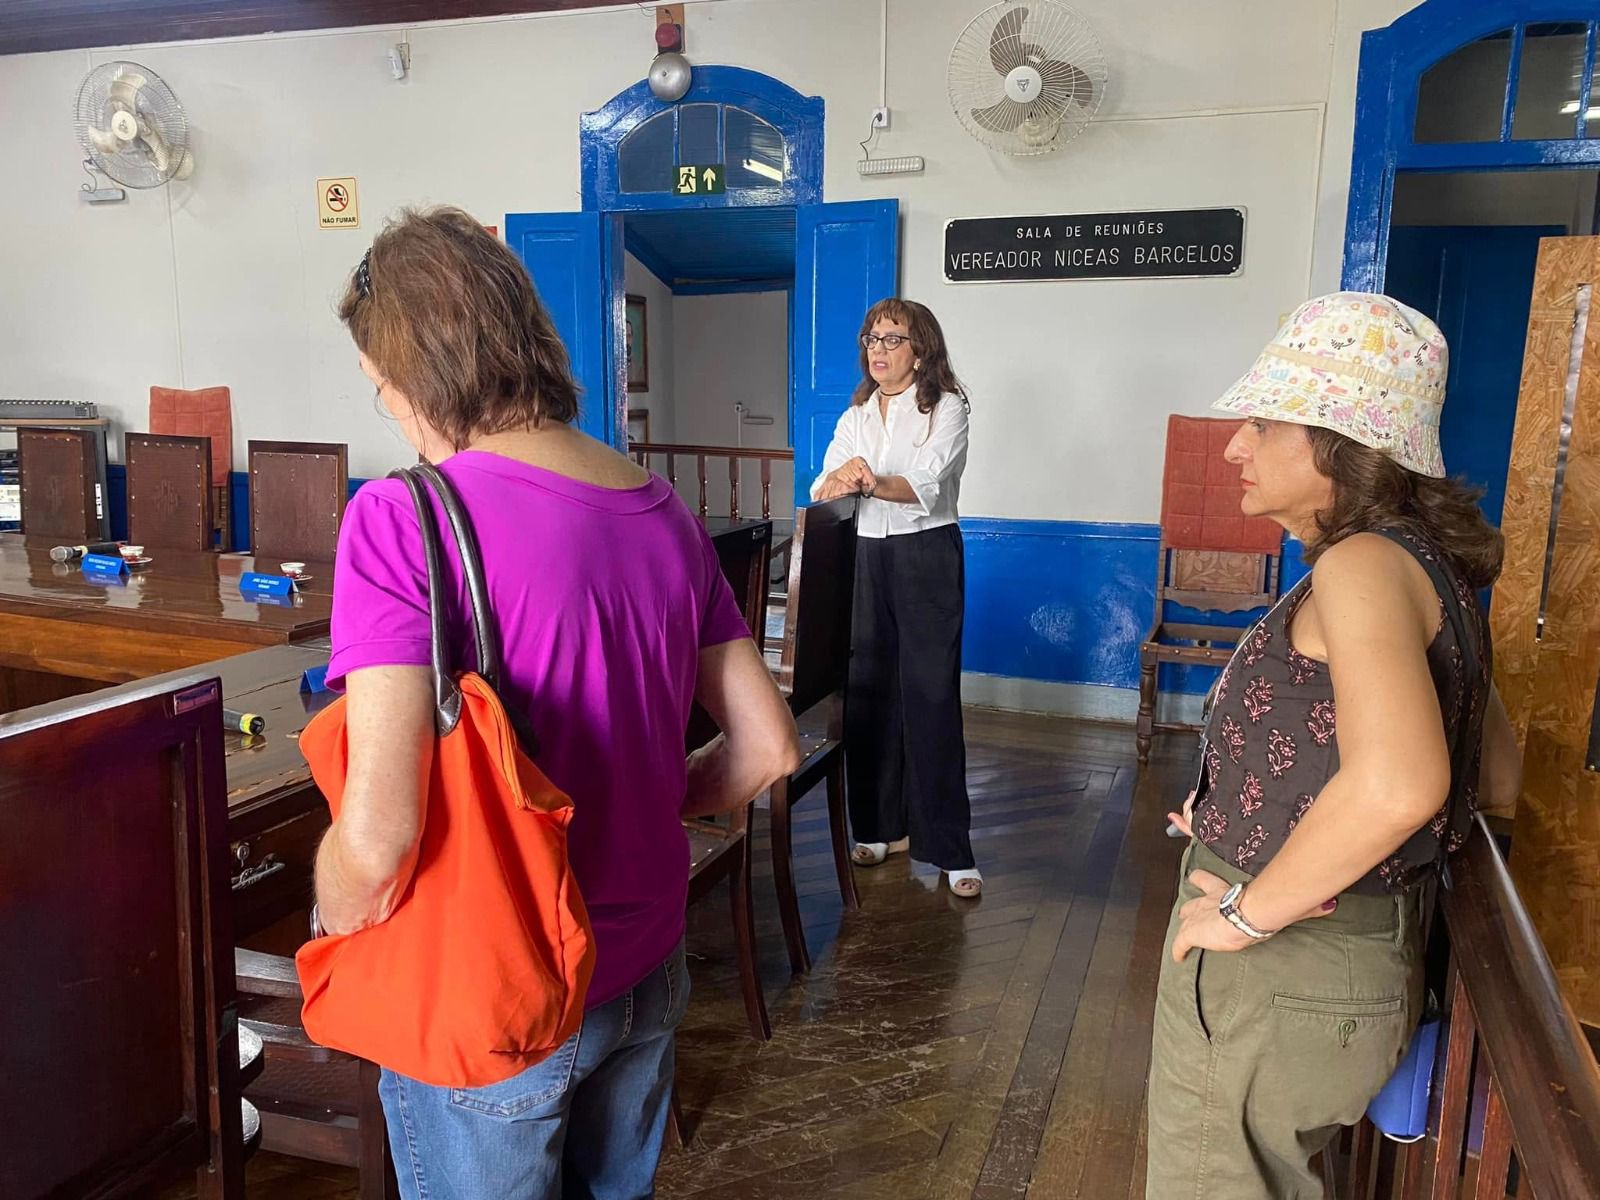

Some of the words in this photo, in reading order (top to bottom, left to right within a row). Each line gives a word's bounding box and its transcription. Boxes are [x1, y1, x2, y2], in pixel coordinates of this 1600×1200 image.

[1016, 226, 1052, 239] SALA
[1066, 226, 1081, 238] DE
[1095, 220, 1164, 236] REUNIÕES
[950, 250, 1042, 270] VEREADOR
[1054, 248, 1120, 268] NICEAS
[1134, 244, 1234, 265] BARCELOS
